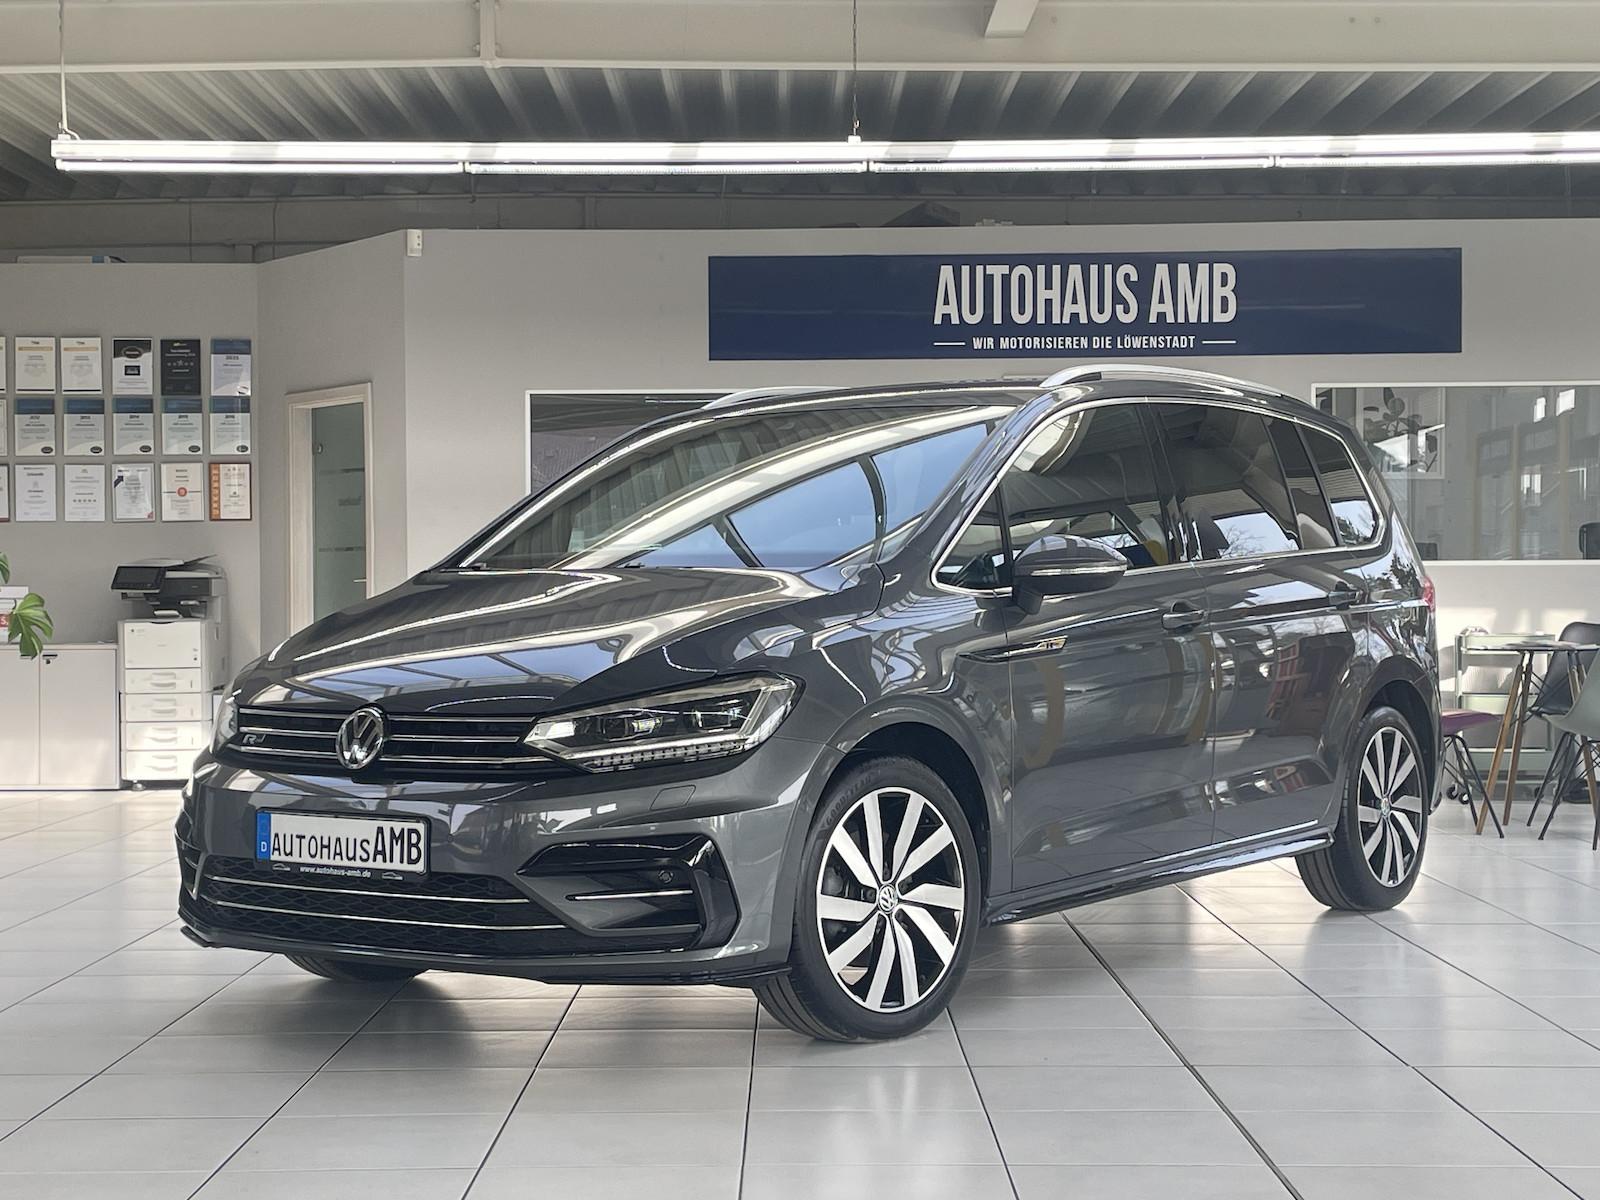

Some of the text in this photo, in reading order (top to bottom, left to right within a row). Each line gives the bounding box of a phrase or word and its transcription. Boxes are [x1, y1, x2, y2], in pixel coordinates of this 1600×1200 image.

[933, 263, 1237, 325] AUTOHAUS AMB
[972, 334, 1196, 350] WIR MOTORISIEREN DIE LÖWENSTADT
[260, 841, 268, 852] D
[300, 866, 371, 878] www.autohaus-amb.de
